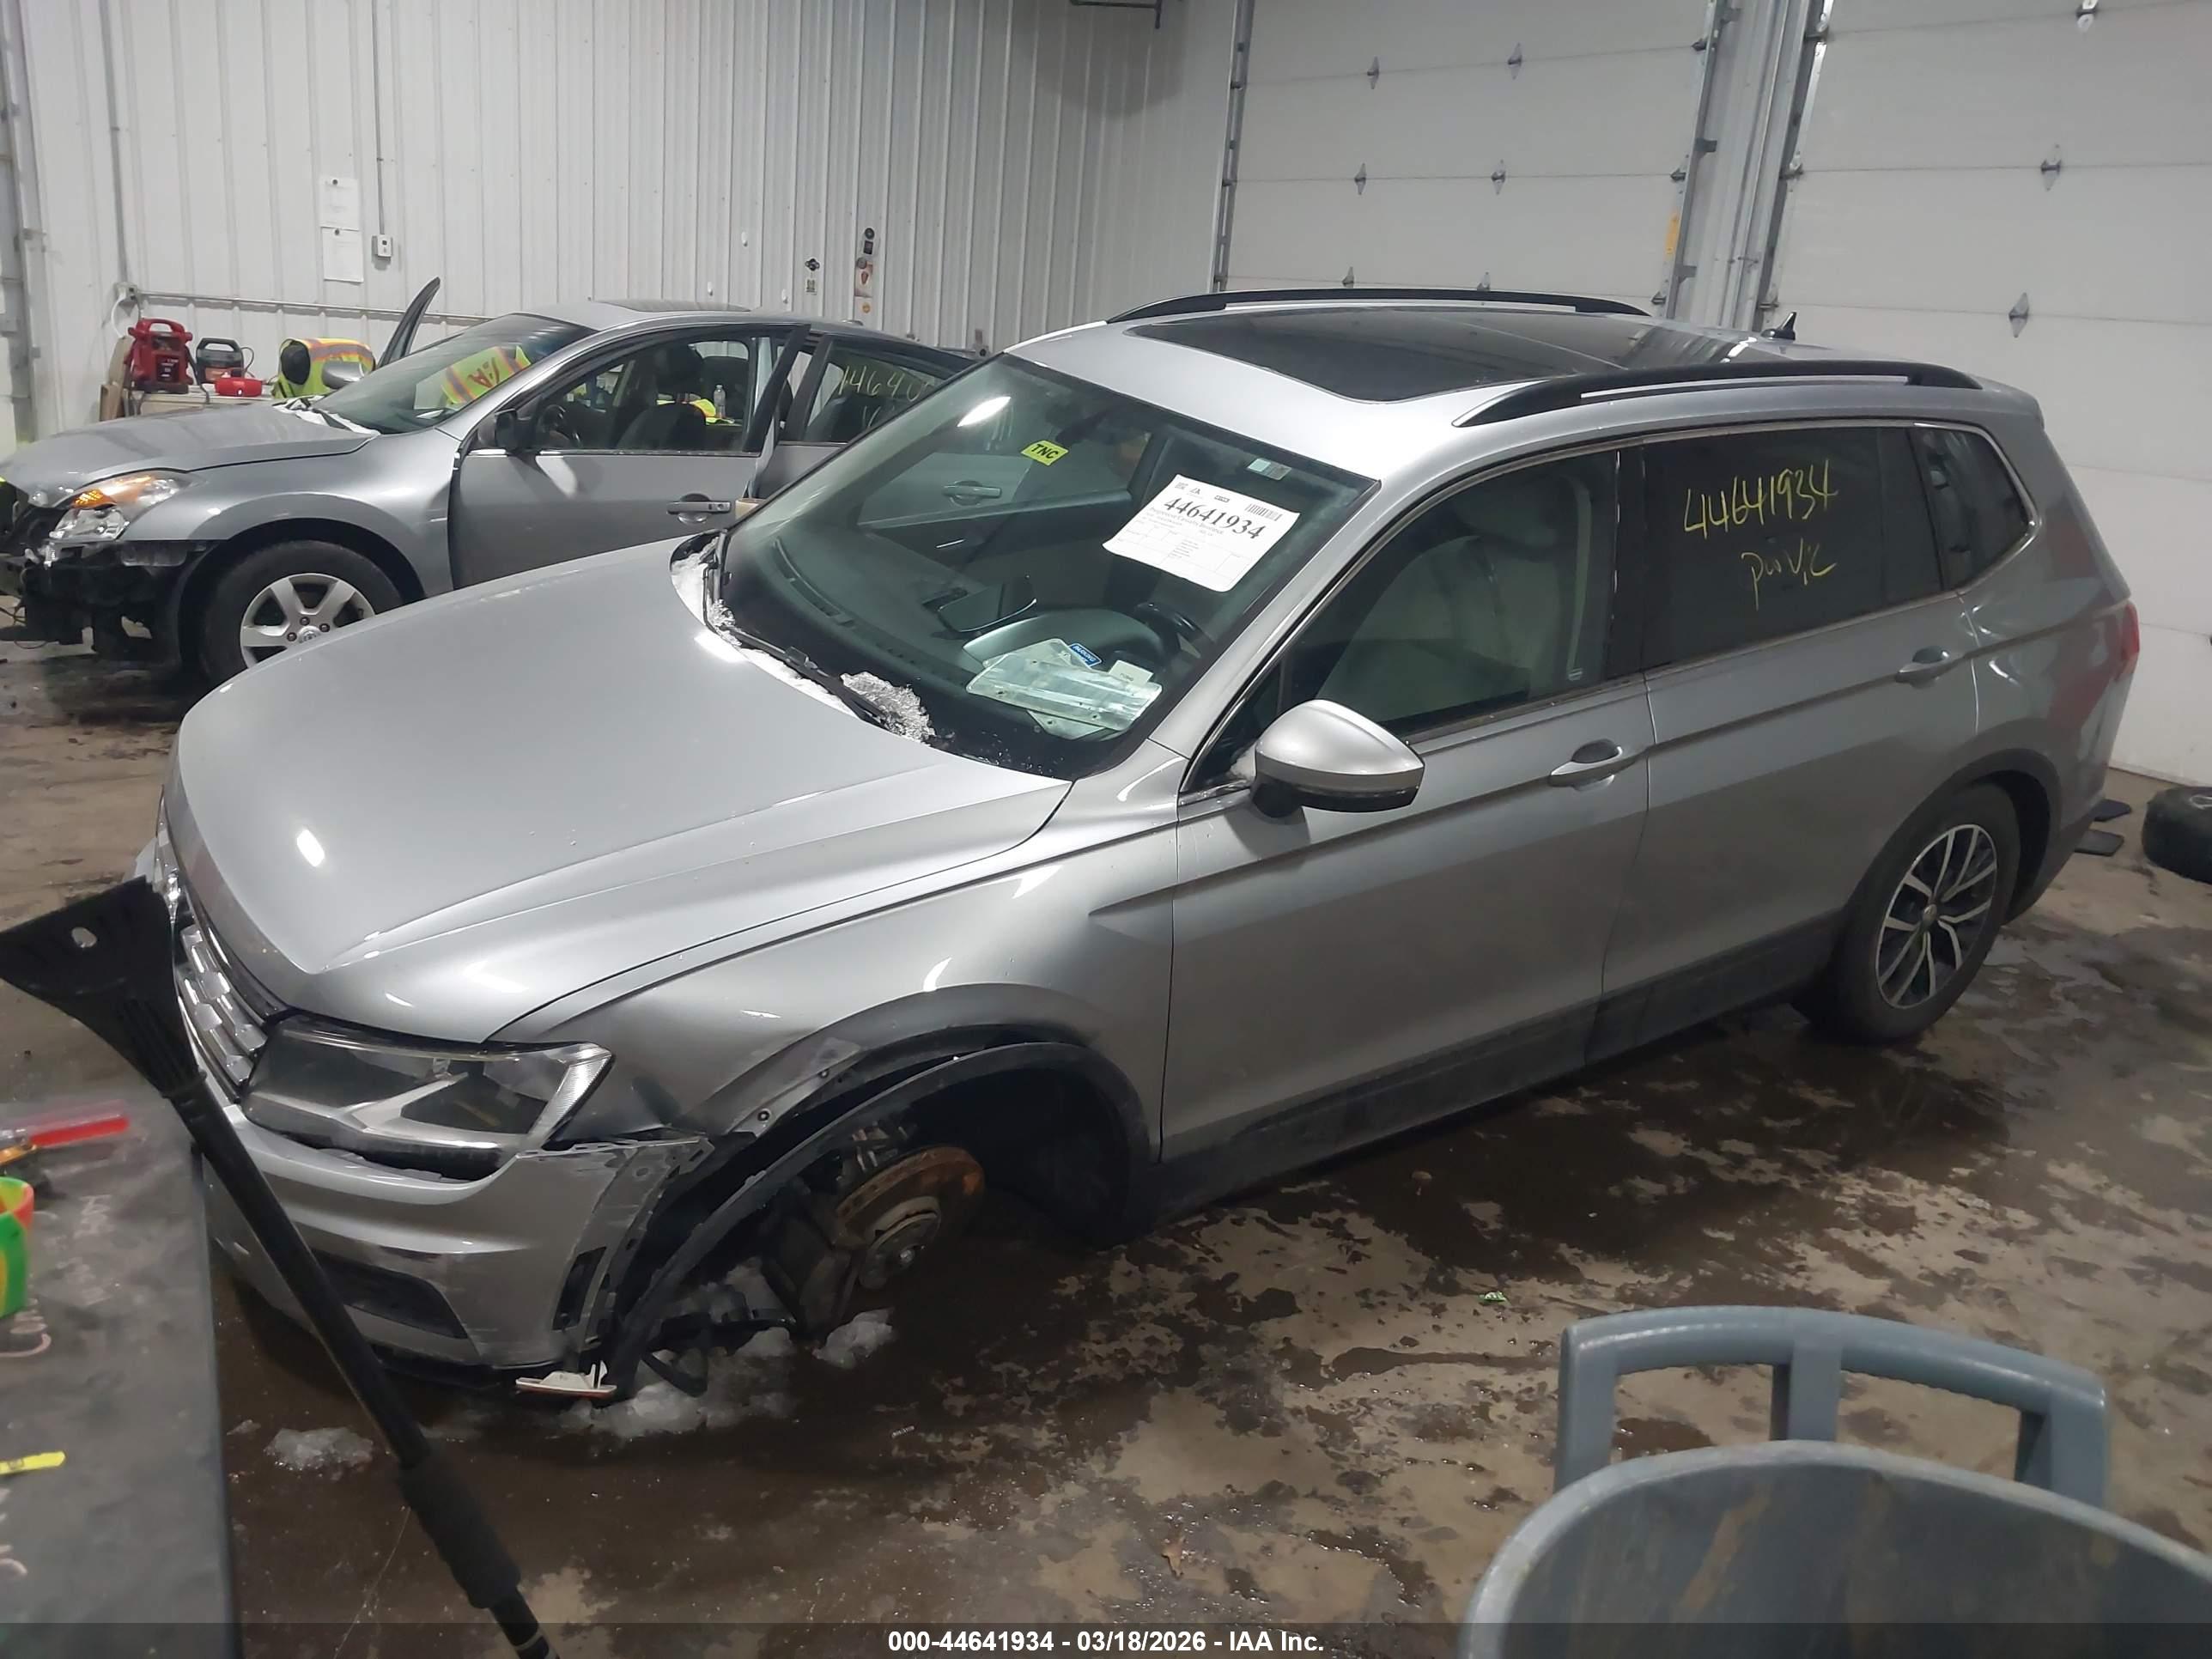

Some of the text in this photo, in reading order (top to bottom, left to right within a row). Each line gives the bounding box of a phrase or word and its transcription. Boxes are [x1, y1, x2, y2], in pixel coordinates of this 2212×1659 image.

[1030, 443, 1059, 459] TNC
[1164, 497, 1267, 539] 44641934
[1683, 458, 1839, 540] 44641934
